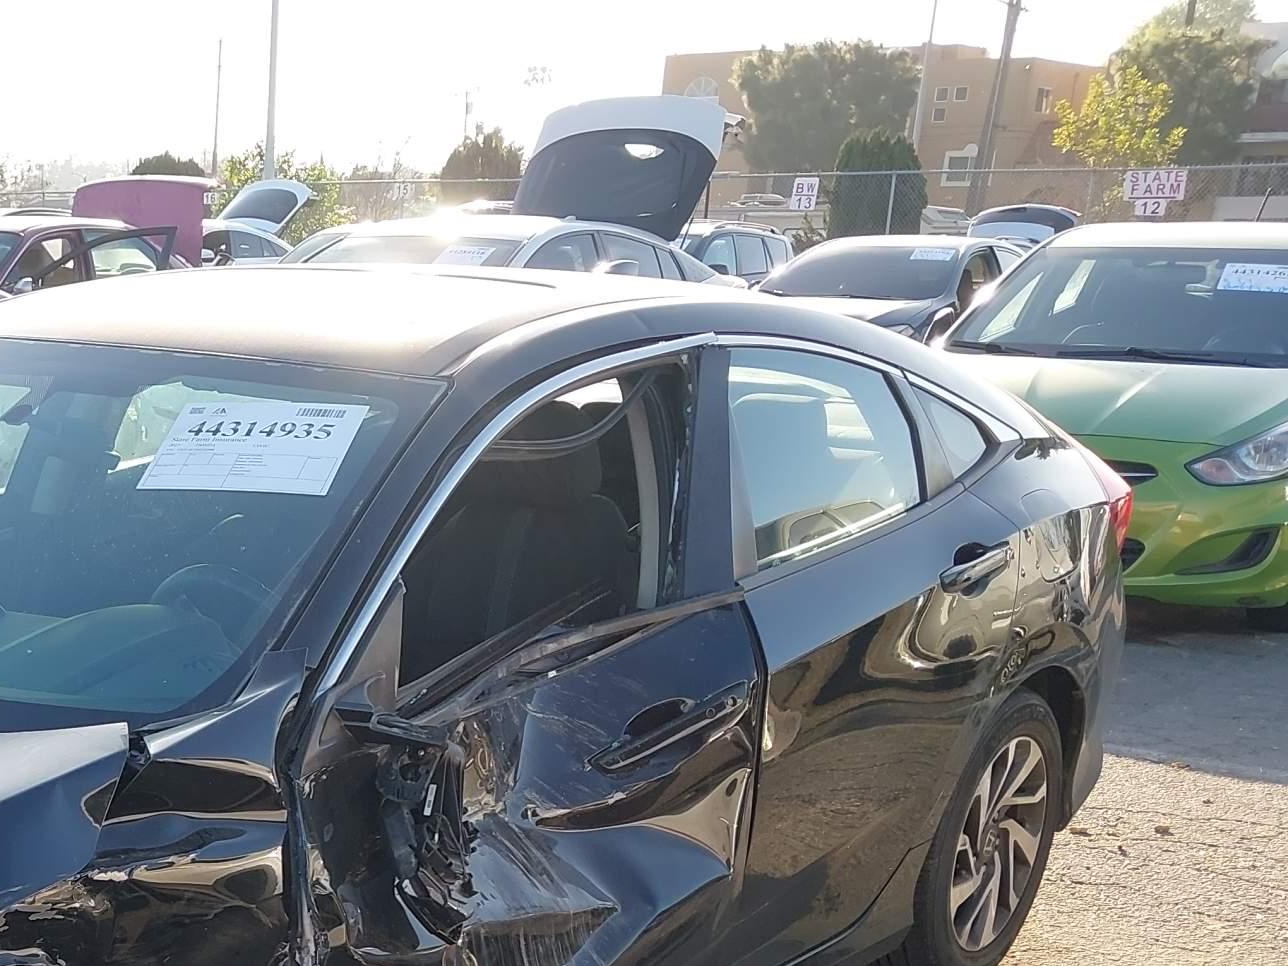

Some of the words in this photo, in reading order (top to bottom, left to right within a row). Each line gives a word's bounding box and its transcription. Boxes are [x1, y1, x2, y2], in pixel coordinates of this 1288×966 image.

[1130, 170, 1185, 184] STATE
[1130, 183, 1181, 196] FARM
[795, 197, 813, 209] 13
[1141, 201, 1161, 215] 12
[187, 420, 336, 440] 44314935
